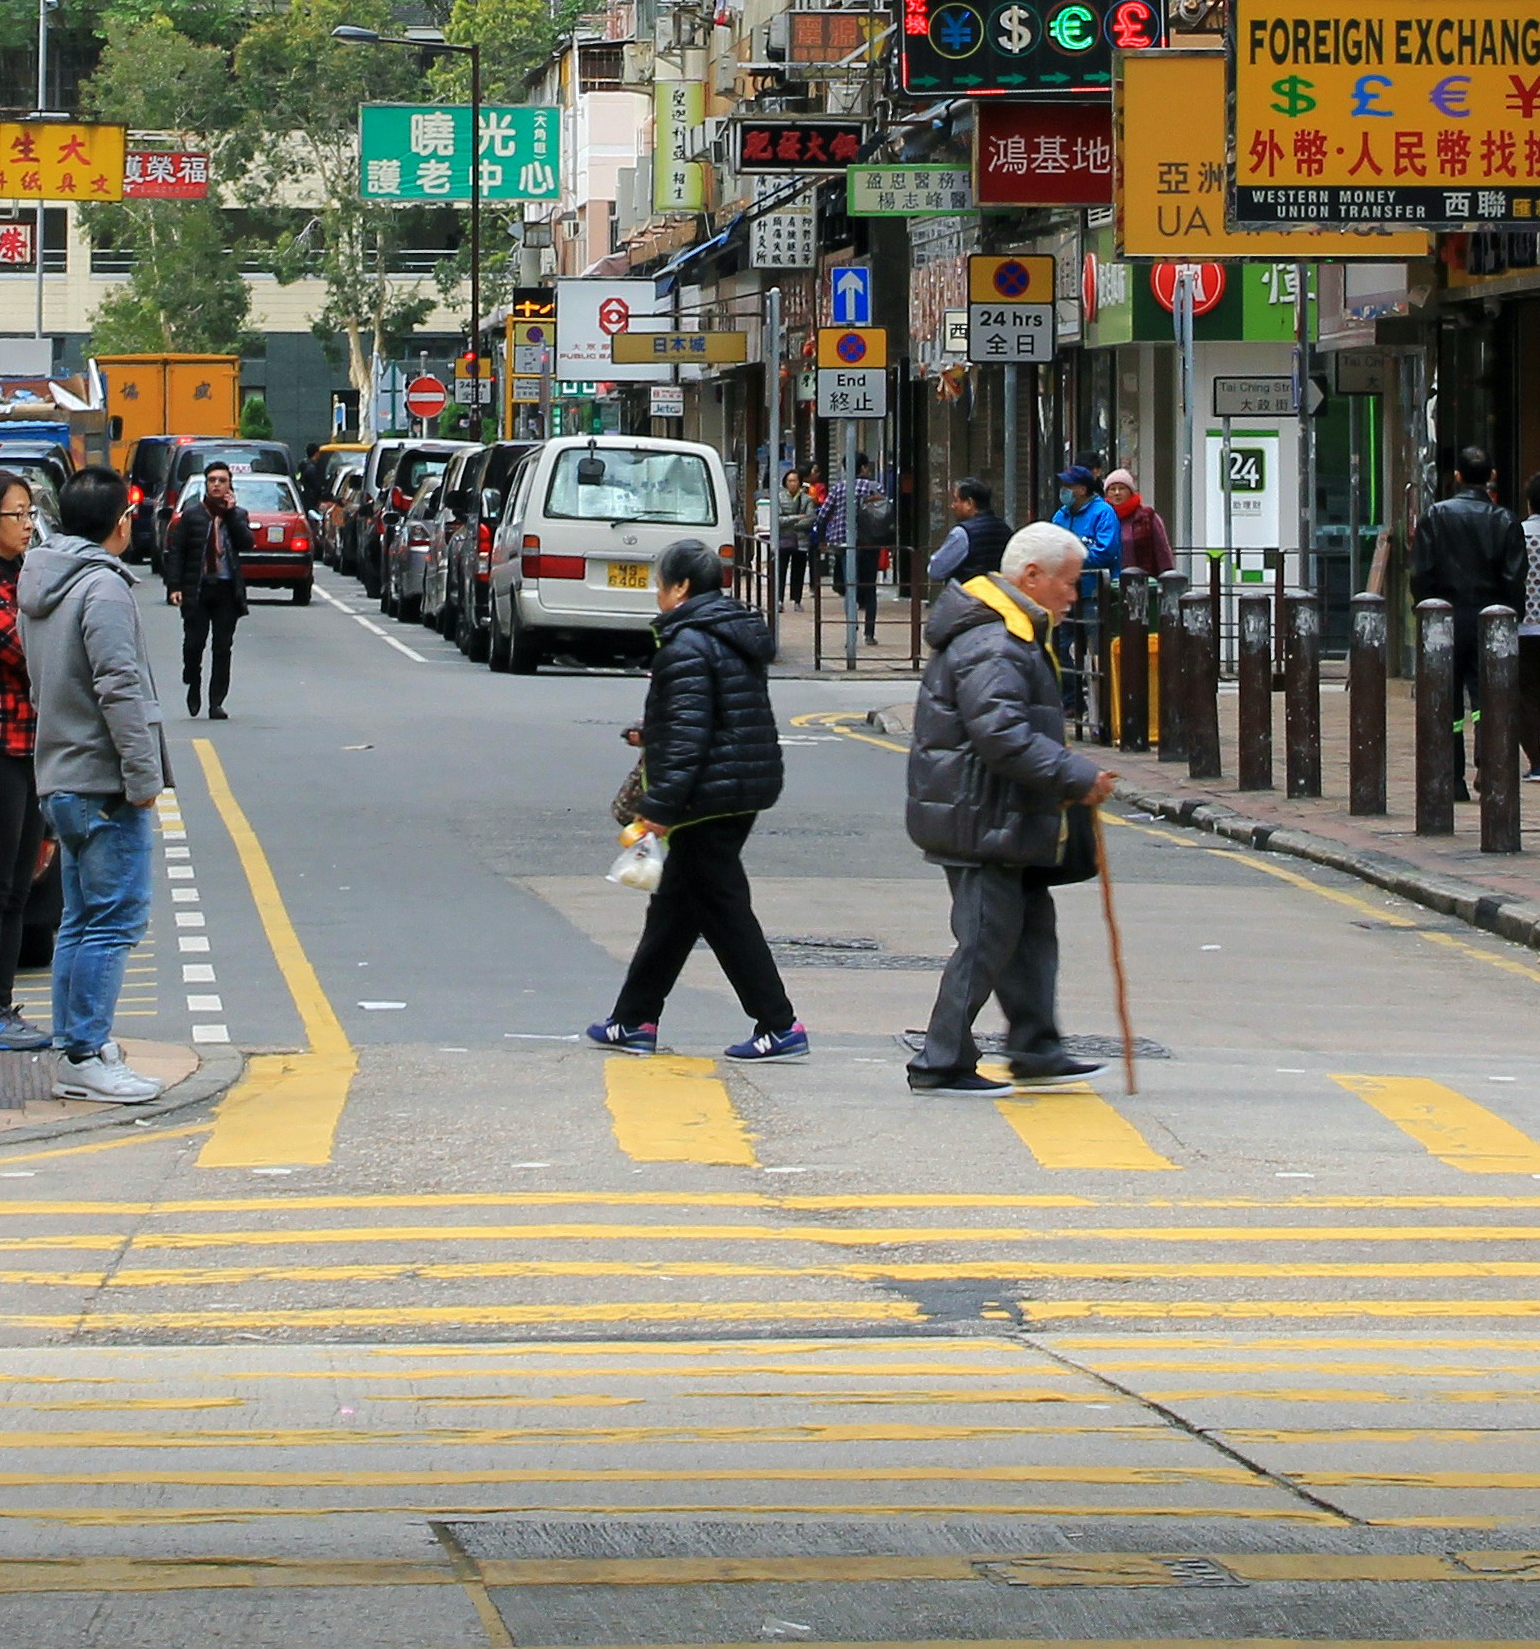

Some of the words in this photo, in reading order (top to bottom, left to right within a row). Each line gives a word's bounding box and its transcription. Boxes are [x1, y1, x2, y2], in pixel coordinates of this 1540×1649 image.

[1249, 18, 1384, 65] FOREIGN
[411, 111, 516, 157] 曉光
[988, 135, 1112, 175] 鴻基地
[367, 159, 555, 197] 護老中心
[1252, 190, 1329, 203] WESTERN
[1339, 190, 1396, 203] MONEY
[1277, 205, 1329, 219] UNION
[1339, 205, 1426, 219] TRANSFER
[1157, 205, 1211, 237] UA
[979, 311, 1006, 326] 24
[1013, 310, 1043, 327] hrs
[653, 336, 706, 353] 日本城
[986, 333, 1035, 355] 全日
[837, 374, 867, 387] End
[1220, 381, 1238, 393] Tai
[1240, 381, 1270, 394] Ching
[1273, 381, 1293, 393] Str
[829, 393, 874, 412] 終止
[1240, 398, 1289, 412] 大政街
[609, 575, 647, 588] 6406
